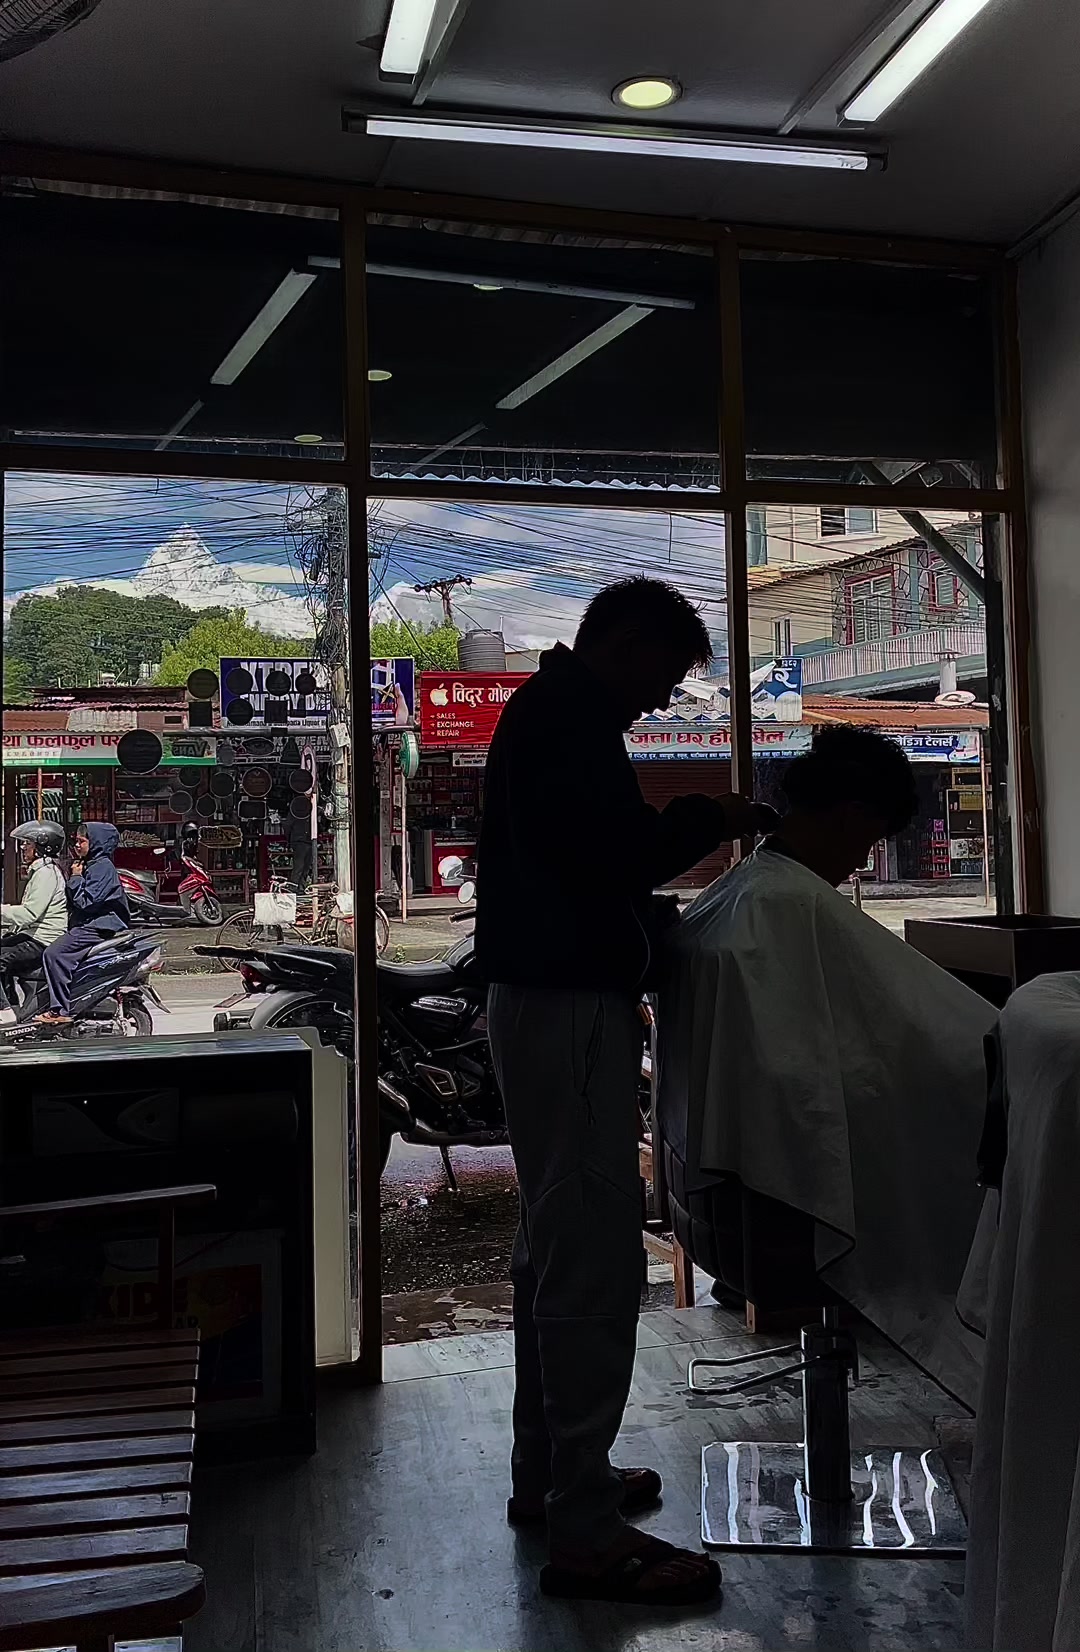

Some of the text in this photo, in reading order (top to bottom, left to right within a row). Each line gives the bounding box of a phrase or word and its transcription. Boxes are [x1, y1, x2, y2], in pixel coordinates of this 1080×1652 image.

[452, 682, 485, 707] विदुर
[436, 712, 456, 720] SALES
[436, 729, 460, 737] REPAIR
[676, 732, 709, 749] घर
[924, 735, 954, 747] टेलर्स
[5, 1026, 37, 1037] HONDA
